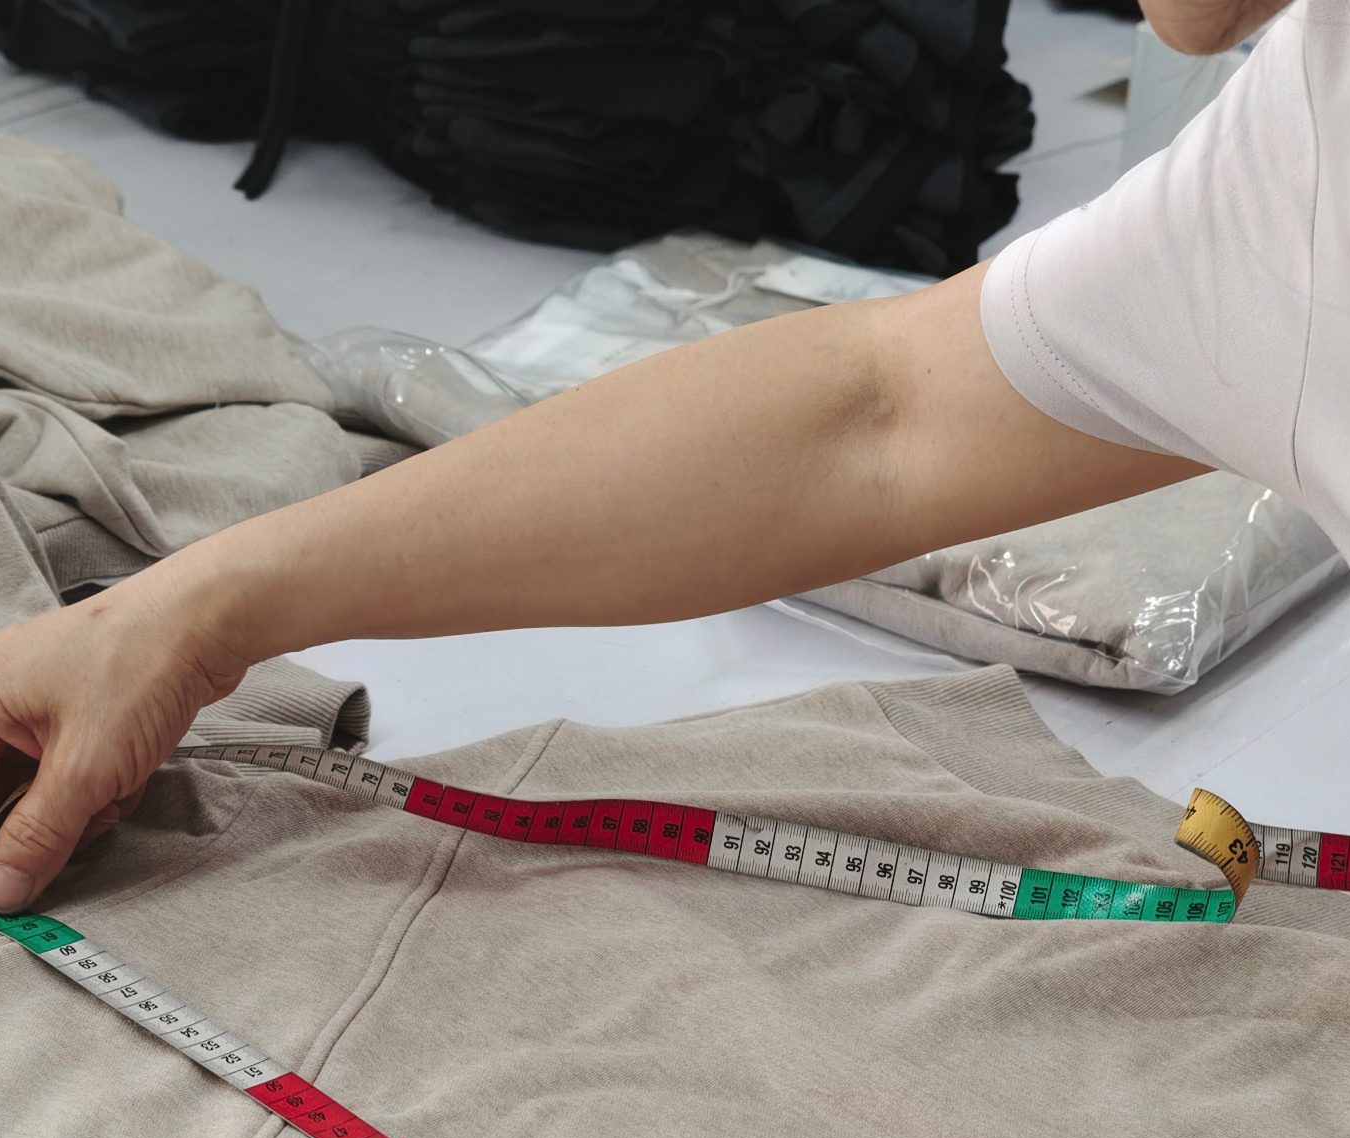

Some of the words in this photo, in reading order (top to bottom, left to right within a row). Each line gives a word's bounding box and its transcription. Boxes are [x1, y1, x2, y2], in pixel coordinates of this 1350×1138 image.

[331, 763, 348, 774] 78
[362, 772, 379, 784] 79
[392, 782, 408, 796] 80
[603, 816, 618, 830] 87
[632, 819, 649, 834] 88
[663, 823, 678, 839] 89
[695, 827, 709, 845] 90
[724, 836, 740, 850] 91
[754, 840, 771, 855] 92
[785, 845, 801, 861] 93
[815, 851, 831, 866] 94
[846, 857, 862, 873] 95
[877, 862, 893, 878] 96
[907, 868, 924, 884] 97
[938, 874, 954, 890] 98
[969, 880, 985, 895] 99
[1030, 886, 1048, 905] 101
[1061, 889, 1079, 908] 102
[1155, 900, 1173, 920] 105
[1187, 903, 1202, 921] 106
[1229, 839, 1248, 864] 43
[1276, 843, 1290, 866] 119
[1303, 847, 1317, 869] 120
[1331, 852, 1346, 873] 121
[59, 945, 77, 956] 60
[78, 959, 98, 970] 59
[98, 973, 118, 983] 58
[121, 987, 137, 998] 57
[139, 1001, 158, 1011] 56
[159, 1014, 178, 1024] 55
[180, 1027, 199, 1038] 54
[201, 1040, 220, 1051] 53
[221, 1054, 242, 1064] 52
[244, 1067, 263, 1077] 51
